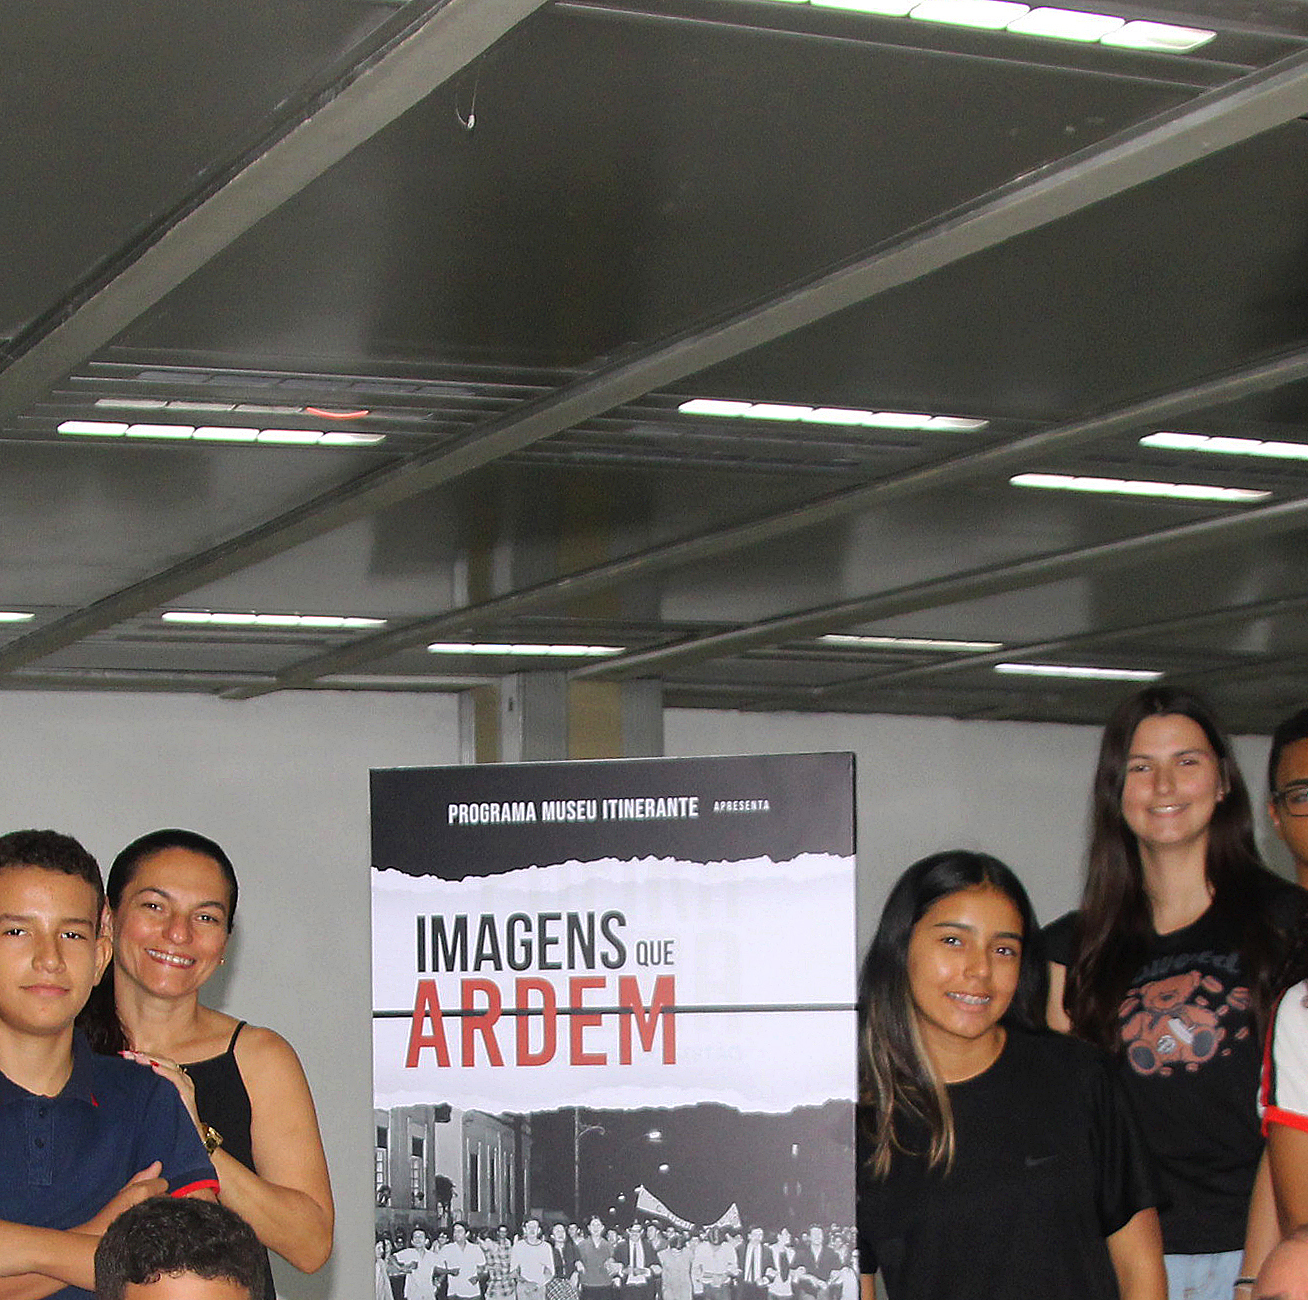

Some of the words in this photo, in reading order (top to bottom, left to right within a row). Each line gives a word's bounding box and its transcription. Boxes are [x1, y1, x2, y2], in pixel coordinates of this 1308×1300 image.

[448, 801, 537, 824] PROGRAMA
[542, 799, 597, 822] MUSEU
[602, 796, 699, 820] ITINERANTE
[713, 799, 770, 812] APRESENTA
[416, 910, 627, 972] IMAGENS
[636, 940, 675, 967] QUE
[405, 974, 677, 1068] ARDEM
